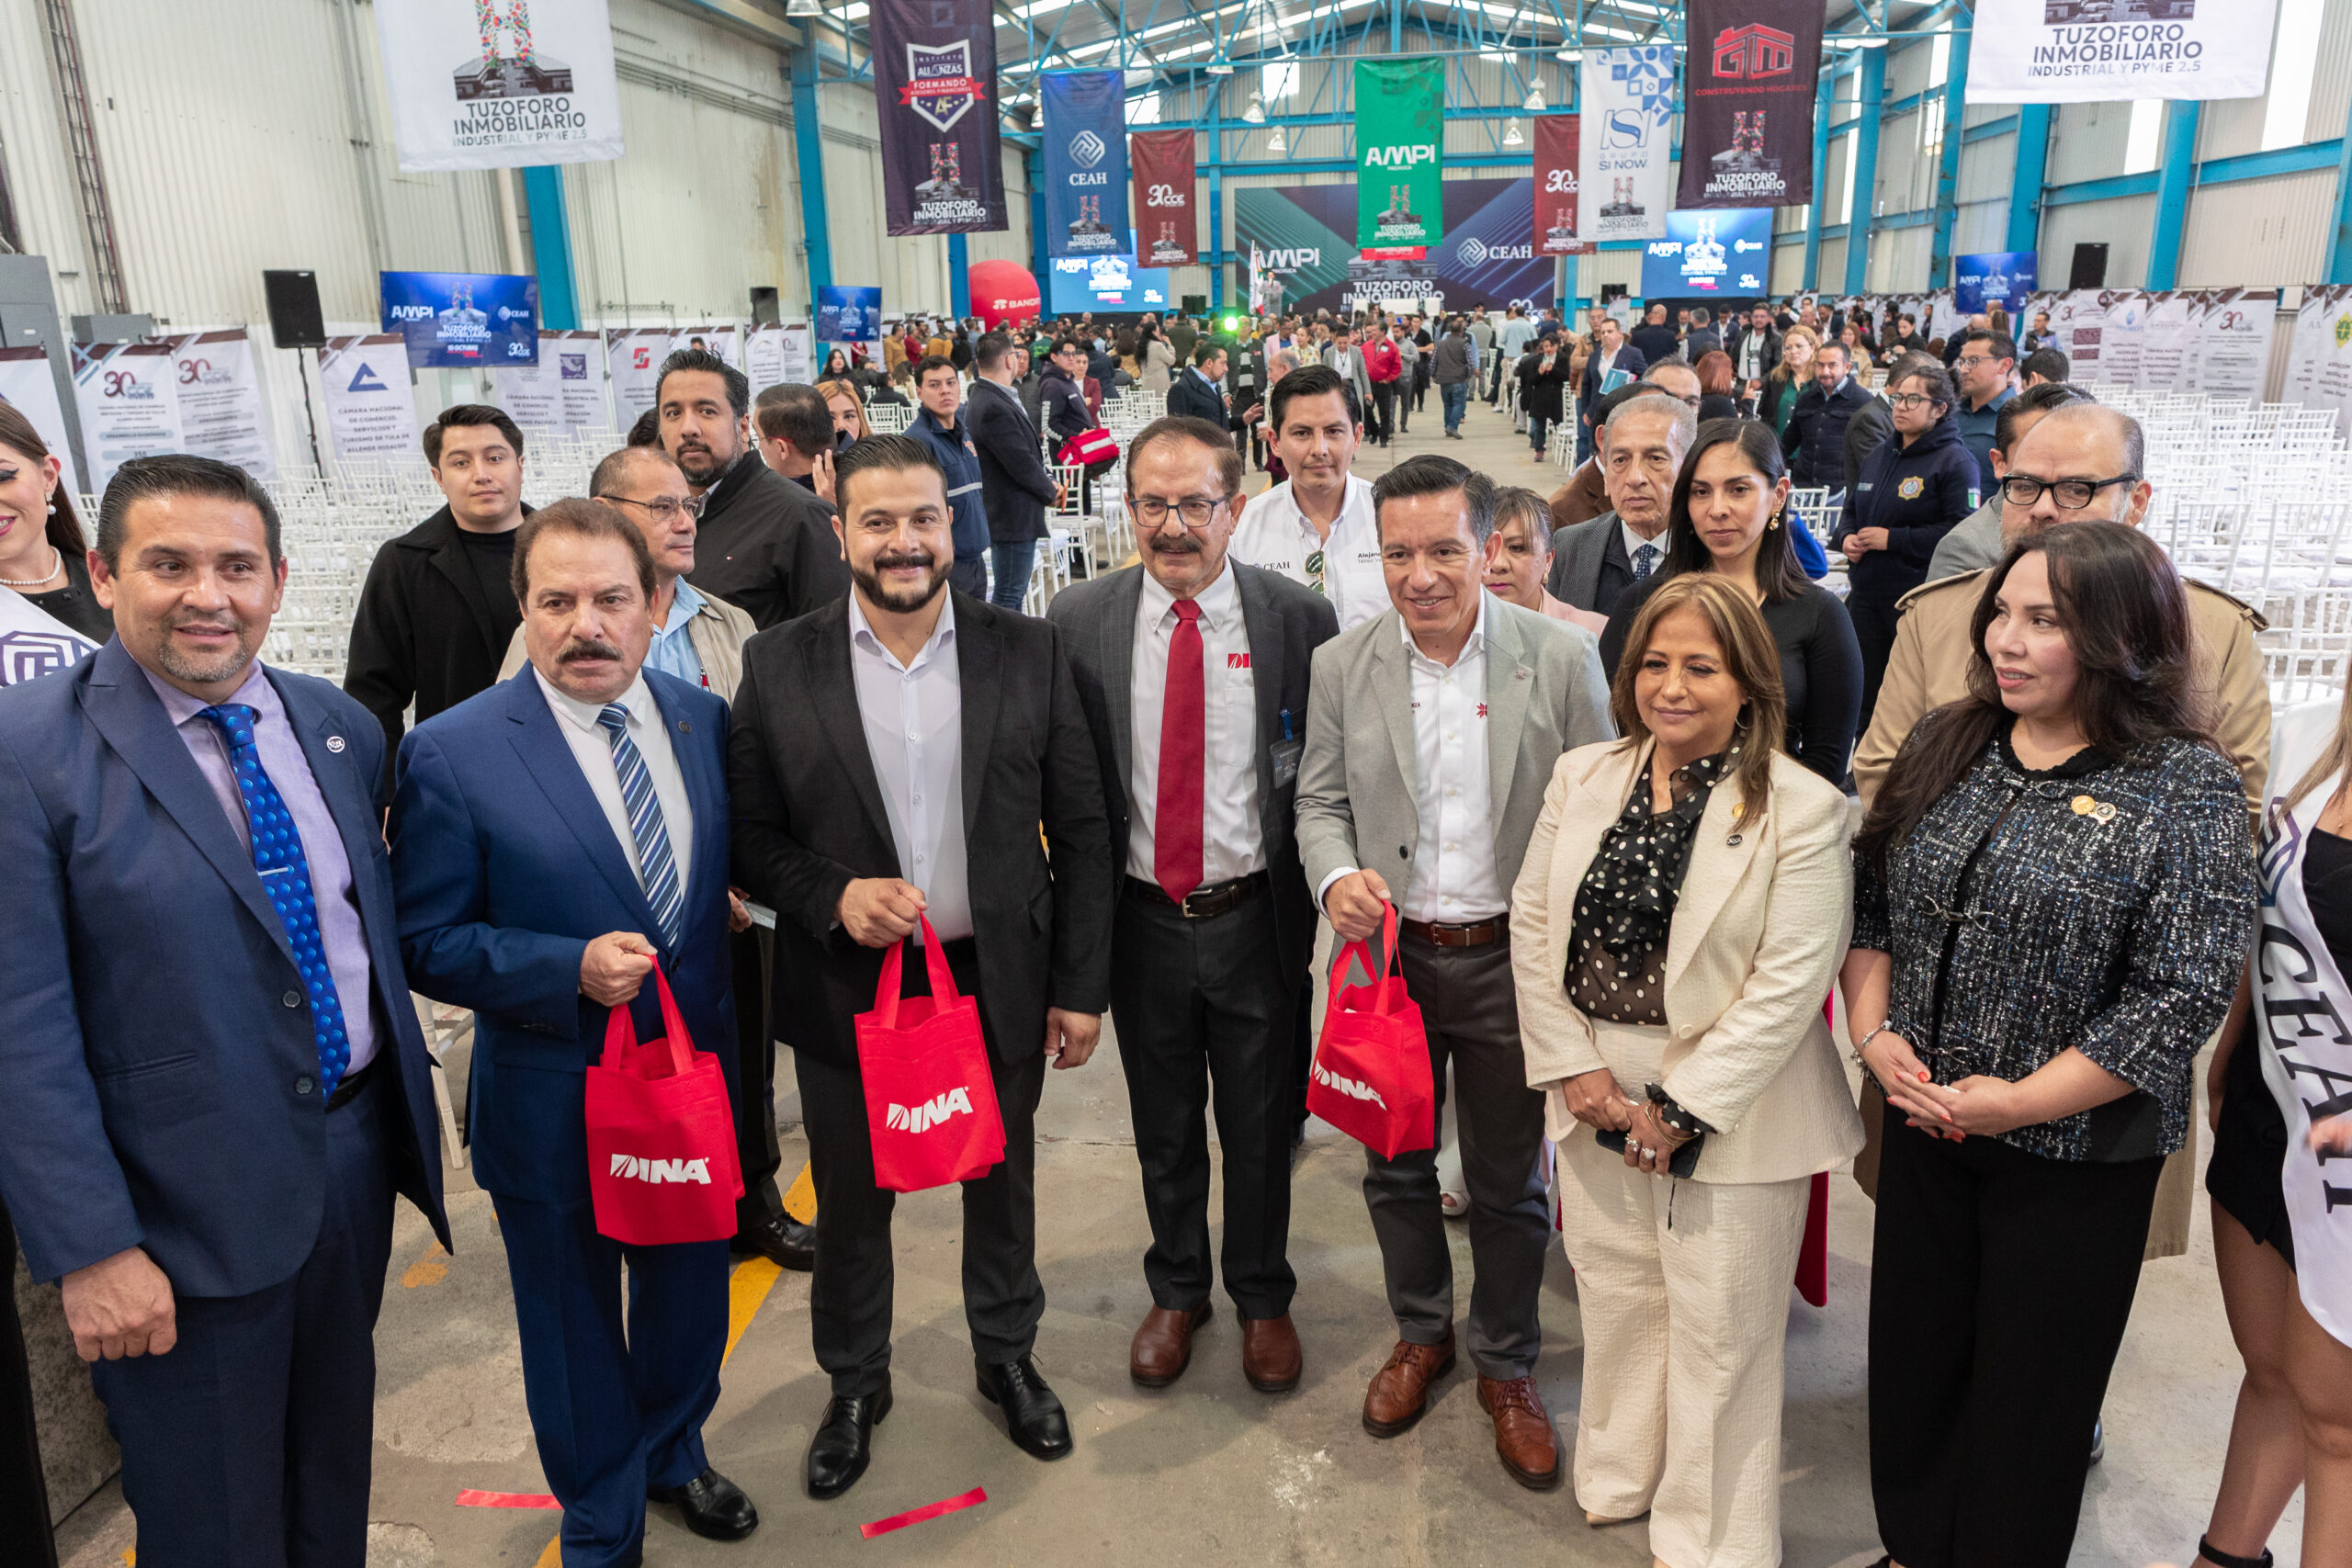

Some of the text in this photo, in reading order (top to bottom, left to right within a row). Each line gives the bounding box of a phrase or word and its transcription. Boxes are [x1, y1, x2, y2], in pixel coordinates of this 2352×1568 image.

[2052, 24, 2184, 45] TUZOFORO
[2033, 41, 2202, 63] INMOBILIARIO
[2028, 63, 2115, 77] INDUSTRIAL
[2178, 61, 2201, 73] 2.5
[913, 78, 967, 90] FORMANDO
[1694, 87, 1765, 96] CONSTRUYENDO
[466, 96, 570, 118] TUZOFORO
[454, 112, 585, 135] INMOBILIARIO
[452, 134, 523, 147] INDUSTRIAL
[571, 130, 588, 140] 2.5
[1364, 144, 1435, 166] AMPI
[1599, 159, 1647, 171] SI NOW
[1069, 172, 1108, 186] CEAH
[1545, 169, 1578, 192] 30 CC
[1714, 172, 1778, 184] TUZOFORO
[1705, 180, 1786, 193] INMOBILIARIO
[1147, 184, 1185, 208] 30 CCE
[920, 199, 978, 211] TUZOFORO
[913, 207, 987, 220] INMOBILIARIO
[1374, 229, 1426, 238] INMOBILIARIO
[1489, 246, 1532, 259] CEAH
[1353, 280, 1433, 294] TUZOFORO
[1009, 297, 1041, 309] BANOR
[391, 306, 434, 319] AMPI
[436, 331, 492, 339] INMOBILIARIO
[178, 358, 211, 384] 30
[104, 371, 136, 397] 30
[1263, 561, 1290, 570] CEAH
[1315, 1059, 1387, 1111] DINA
[886, 1086, 973, 1134] DINA
[610, 1154, 712, 1184] DINA
